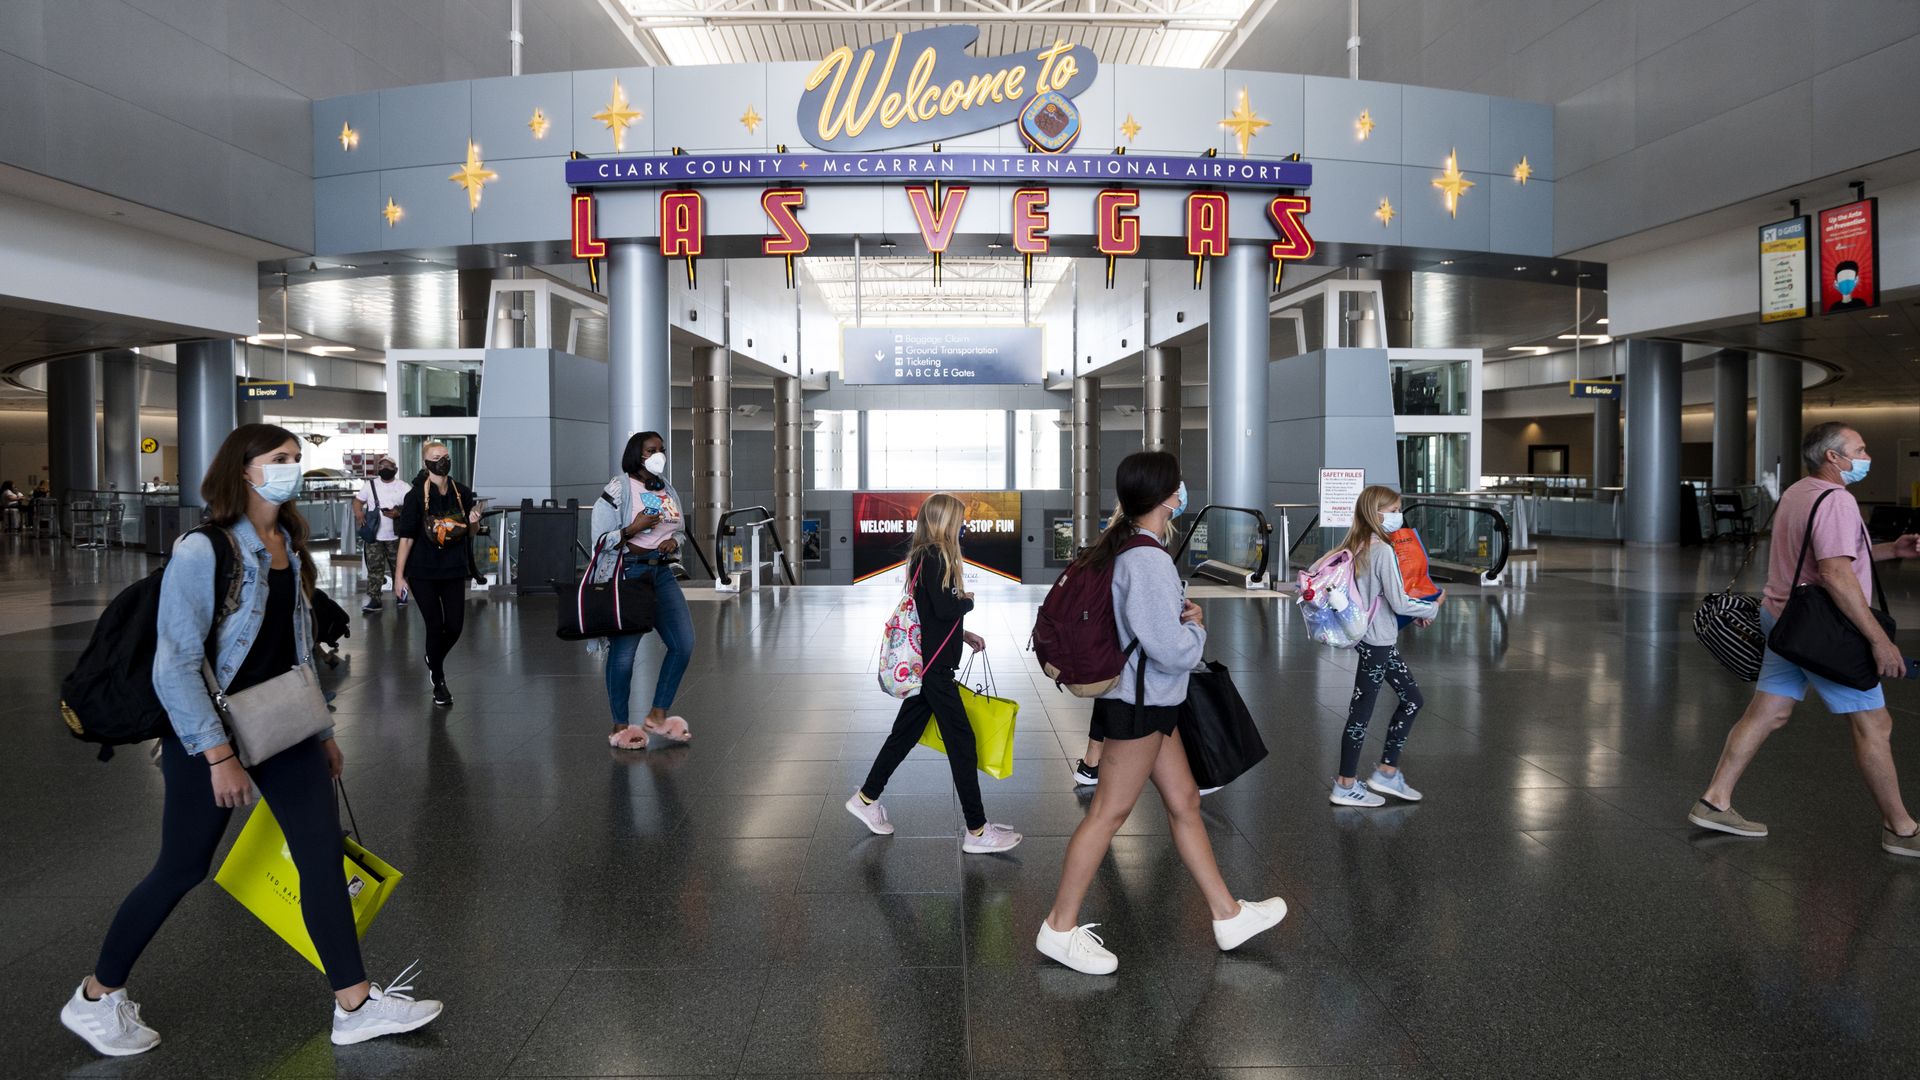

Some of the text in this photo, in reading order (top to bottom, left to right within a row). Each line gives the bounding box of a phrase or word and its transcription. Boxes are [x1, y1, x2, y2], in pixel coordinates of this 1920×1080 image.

[804, 32, 1079, 141] Welcome to
[598, 158, 1281, 179] CLARK COUNTY McCARRAN INTERNATIONAL AIRPORT
[572, 186, 1315, 259] LAS VEGAS
[905, 334, 970, 345] Baggage Claim
[905, 346, 998, 357] Ground Transportation
[906, 357, 941, 367] Ticketing
[906, 369, 976, 377] A B C & E Gates
[256, 388, 278, 396] Elevator
[1592, 386, 1613, 395] Elevator
[860, 519, 904, 534] WELCOME
[963, 519, 993, 533] -STOP
[996, 519, 1015, 533] FUN
[266, 871, 280, 886] TED
